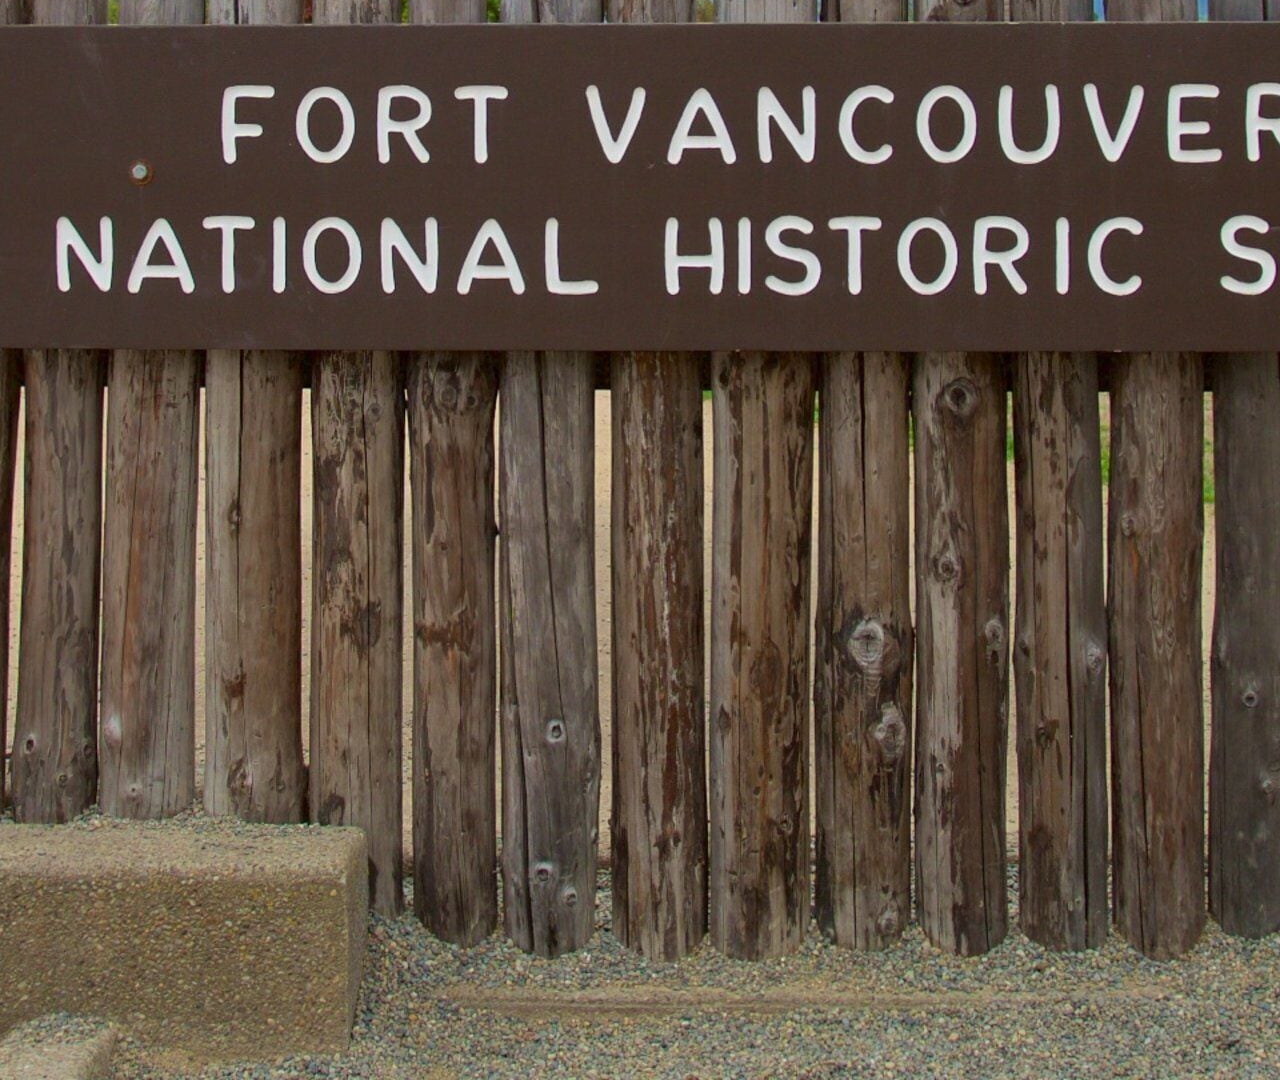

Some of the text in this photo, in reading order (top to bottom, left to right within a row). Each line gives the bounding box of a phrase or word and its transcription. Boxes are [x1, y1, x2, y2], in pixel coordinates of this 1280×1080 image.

[220, 83, 510, 165] FORT
[55, 214, 600, 296] NATIONAL
[663, 214, 1145, 297] HISTORIC
